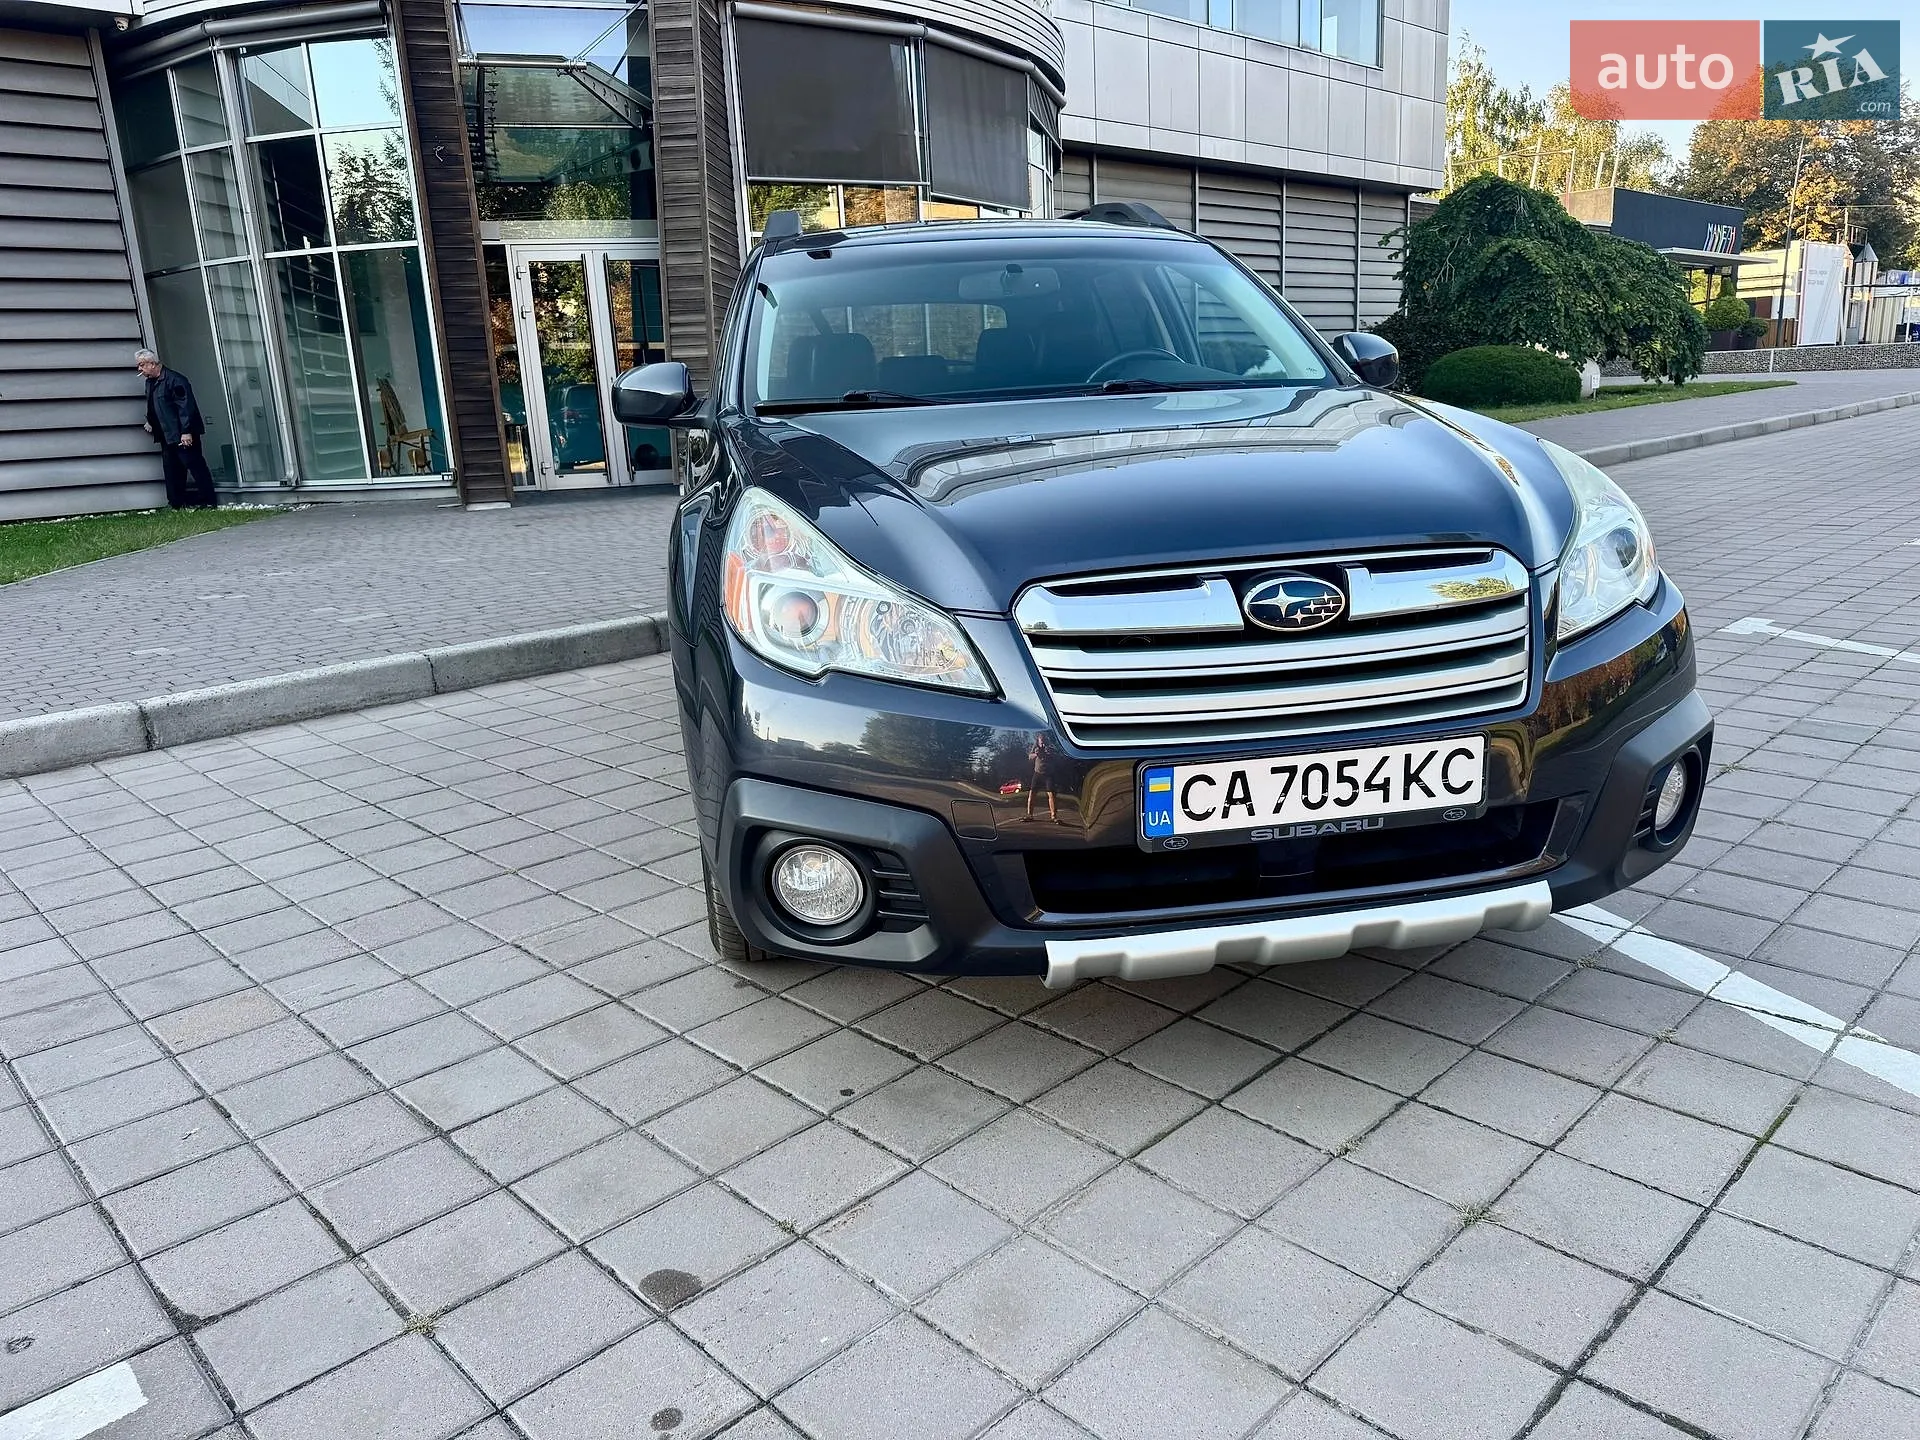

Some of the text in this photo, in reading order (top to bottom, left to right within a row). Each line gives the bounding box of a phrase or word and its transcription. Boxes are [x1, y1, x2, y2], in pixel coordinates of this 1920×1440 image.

[1180, 747, 1476, 822] CA 7054 KC
[1148, 810, 1171, 826] UA
[1250, 817, 1384, 842] SUBARU
